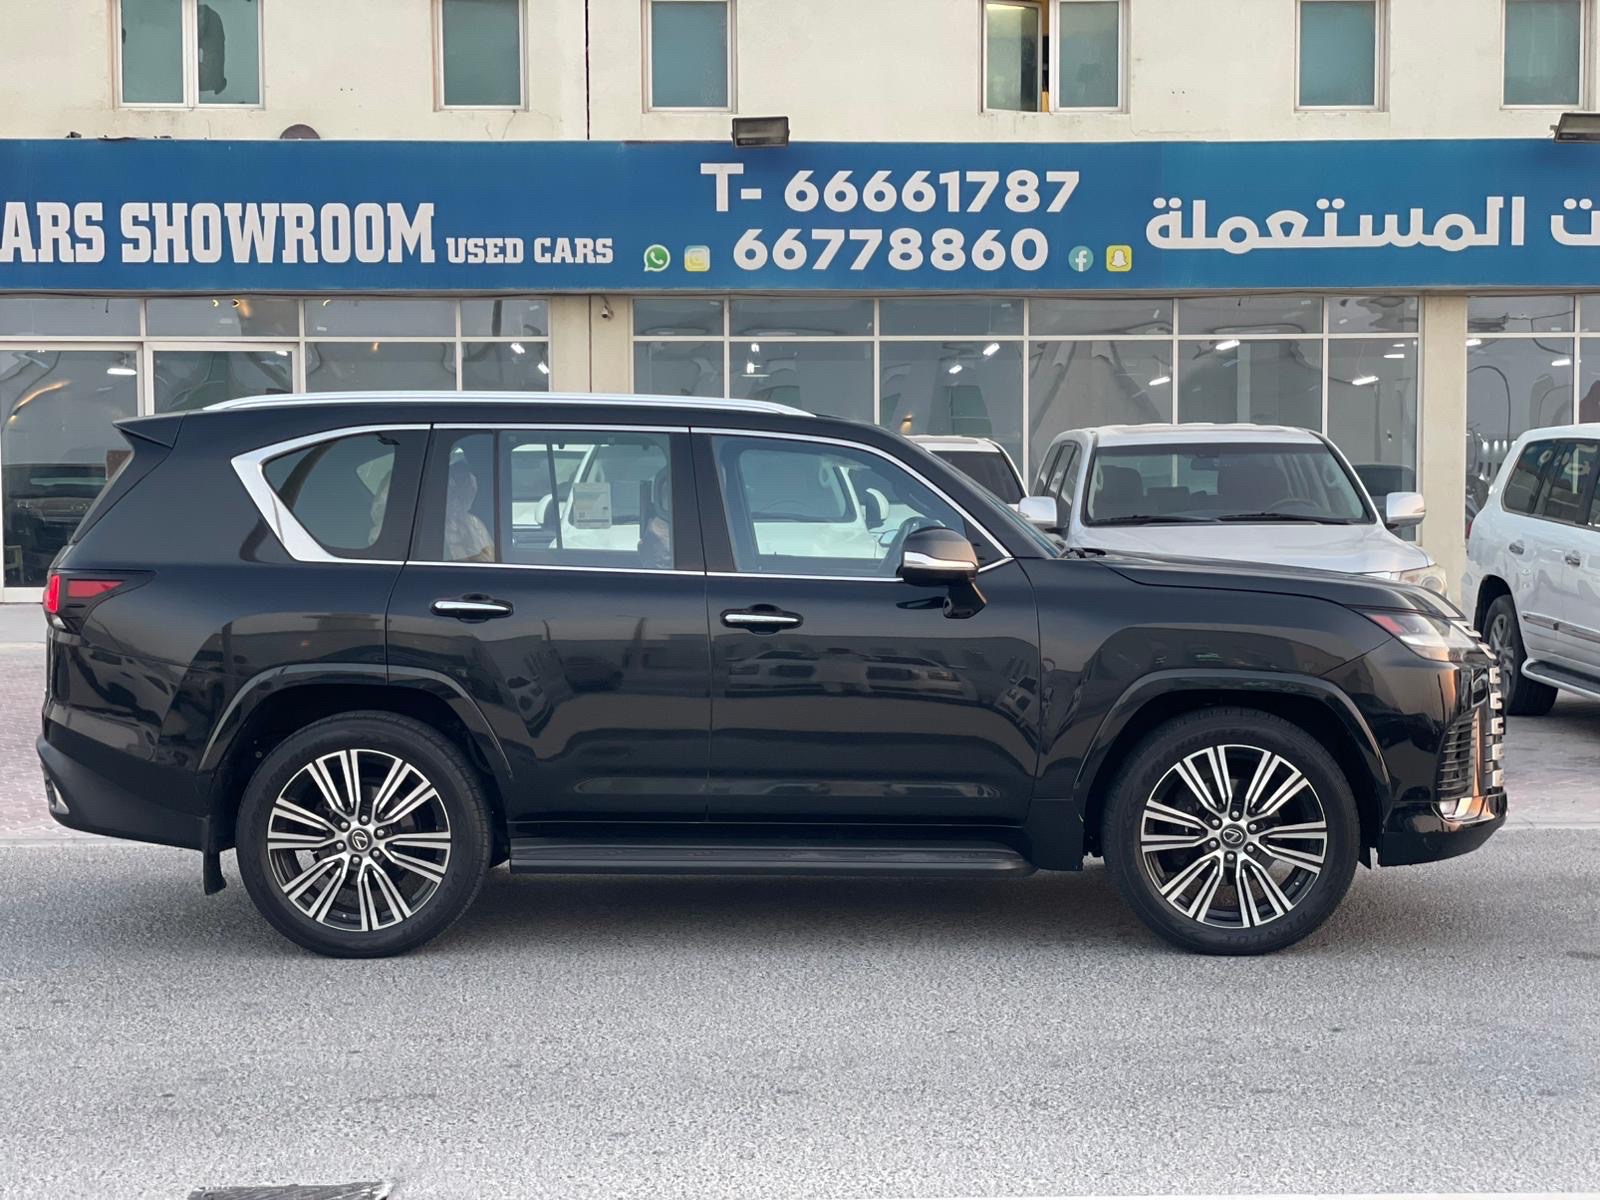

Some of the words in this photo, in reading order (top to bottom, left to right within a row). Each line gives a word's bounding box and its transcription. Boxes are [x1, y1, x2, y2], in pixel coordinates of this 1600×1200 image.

[784, 169, 1080, 213] 66661787
[0, 201, 105, 263] ARS
[120, 202, 436, 264] SHOWROOM
[1145, 196, 1525, 255] المستعملة
[445, 237, 524, 264] USED
[533, 237, 614, 264] CARS
[733, 227, 1049, 271] 66778860
